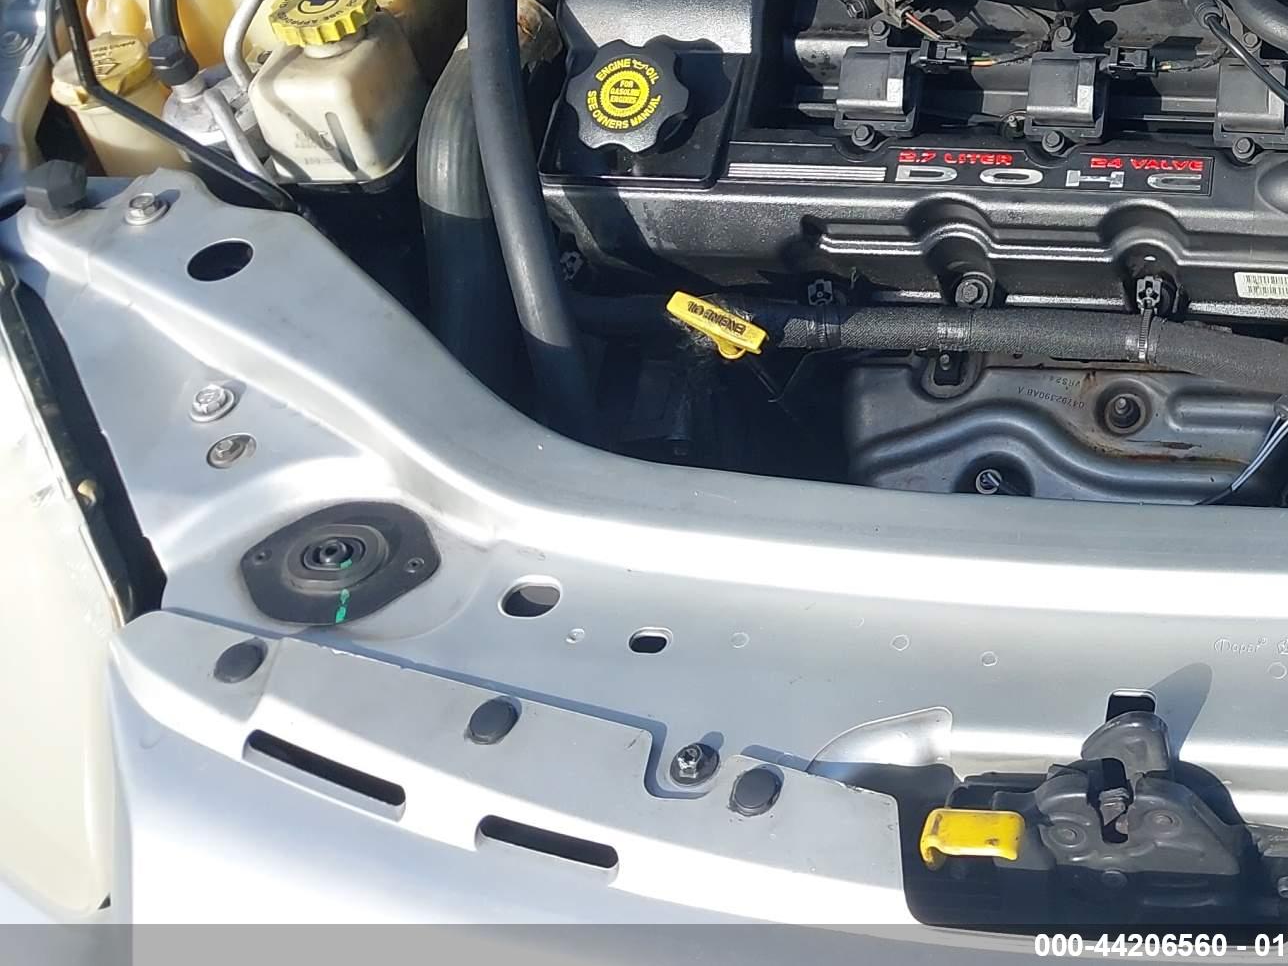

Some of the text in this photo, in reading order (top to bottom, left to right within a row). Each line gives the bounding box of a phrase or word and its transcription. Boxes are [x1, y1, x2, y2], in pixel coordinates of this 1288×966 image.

[596, 58, 660, 85] ENGINE OIL
[620, 80, 634, 88] FOR
[611, 88, 641, 96] GASOLINE
[587, 90, 661, 129] SEE OWNERS MANUAL
[898, 151, 1204, 172] 2.7 LITER 24 VALVE
[895, 165, 1202, 190] DOHC
[687, 301, 747, 336] ENGINE OIL
